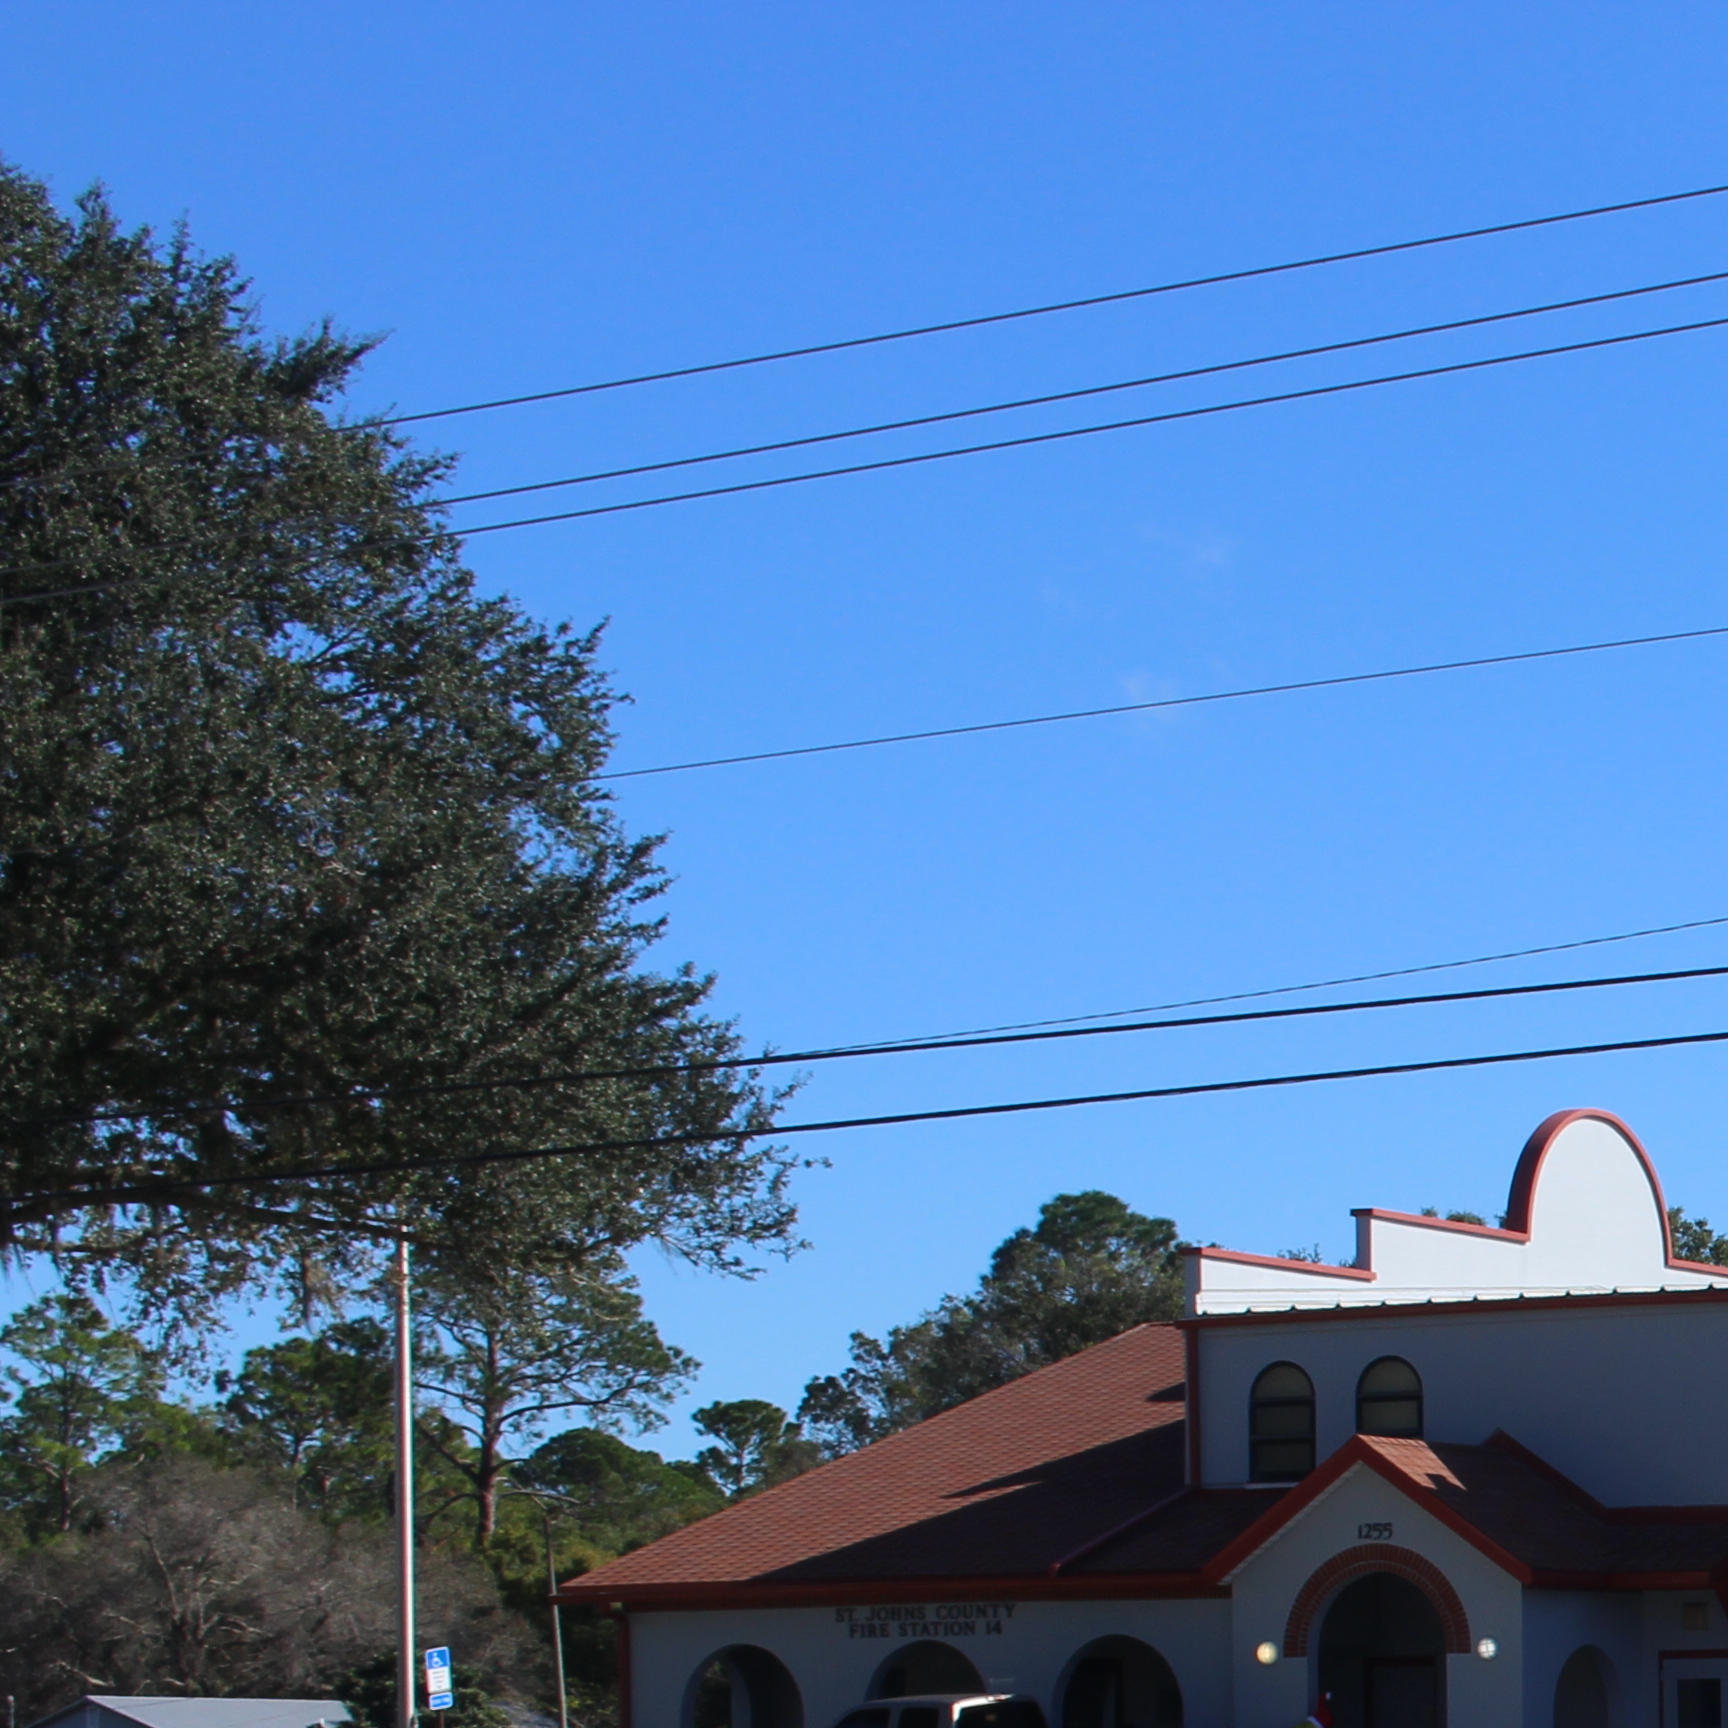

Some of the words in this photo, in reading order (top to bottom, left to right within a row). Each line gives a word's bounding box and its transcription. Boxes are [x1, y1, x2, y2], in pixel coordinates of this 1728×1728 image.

[1357, 1522, 1394, 1541] 1255
[834, 1607, 858, 1623] ST.
[867, 1605, 926, 1621] JOHNS
[936, 1603, 1016, 1619] COUNTY
[849, 1622, 890, 1638] FIRE
[898, 1620, 976, 1637] STATION
[986, 1619, 1003, 1635] 14
